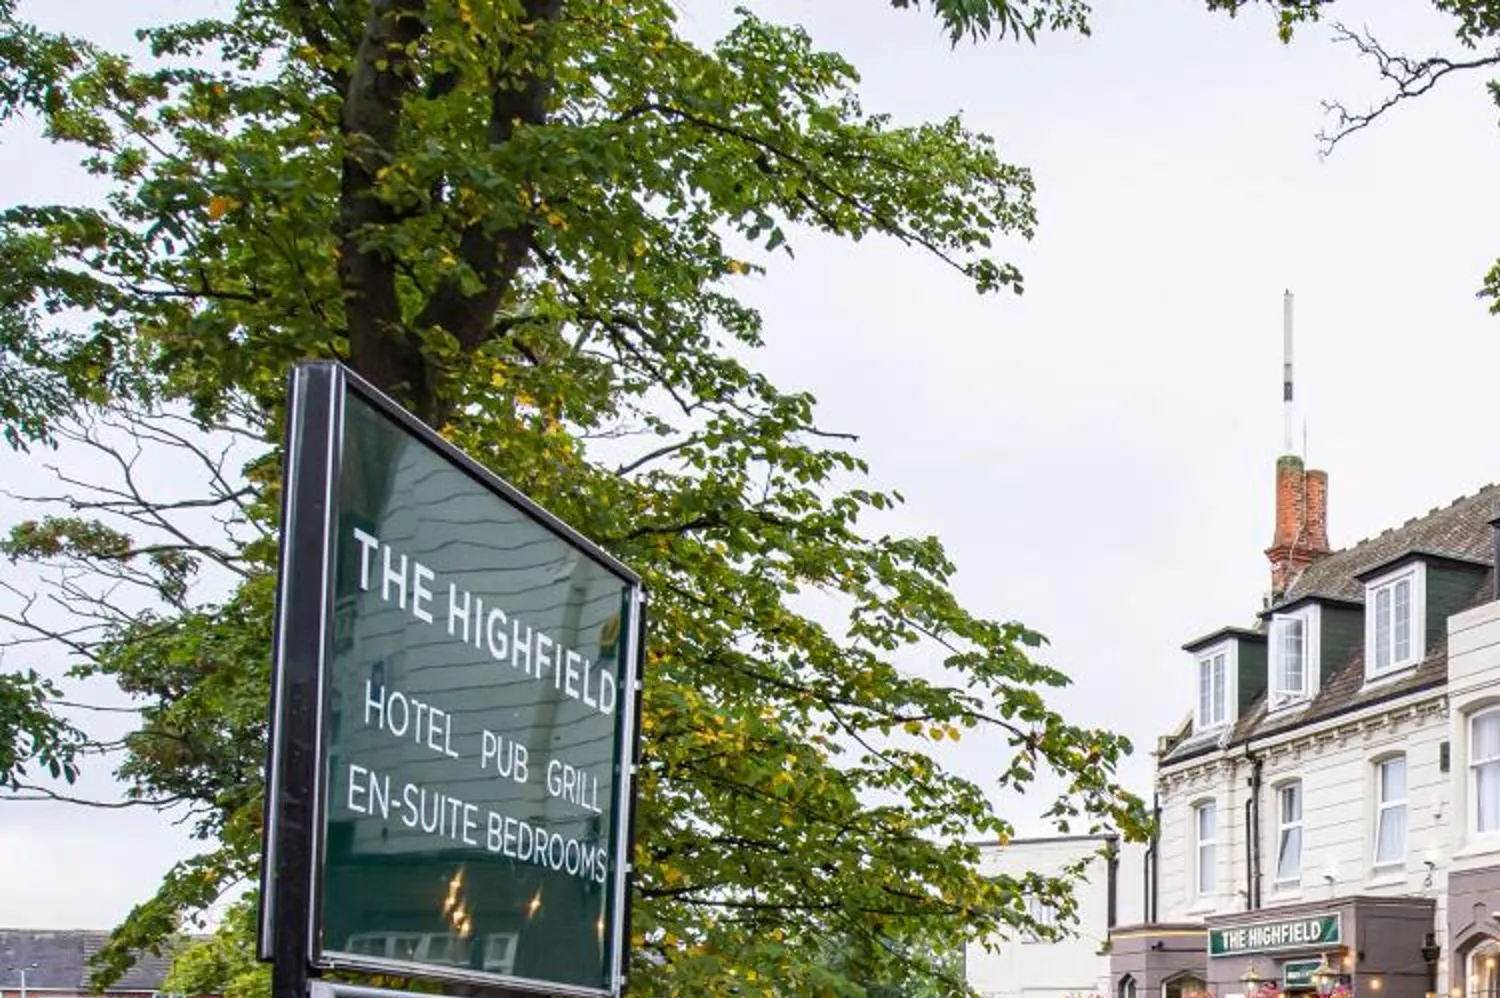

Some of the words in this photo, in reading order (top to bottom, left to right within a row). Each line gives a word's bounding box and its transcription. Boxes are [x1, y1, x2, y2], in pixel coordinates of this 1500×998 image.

[354, 527, 435, 624] THE
[448, 583, 617, 715] HIGHFIELD
[365, 680, 459, 759] HOTEL
[482, 729, 529, 783] PUB
[547, 759, 602, 814] GRILL
[348, 764, 478, 845] EN-SUITE
[487, 811, 607, 883] BEDROOMS
[1221, 931, 1247, 950] THE
[1248, 920, 1321, 947] HIGHFIELD
